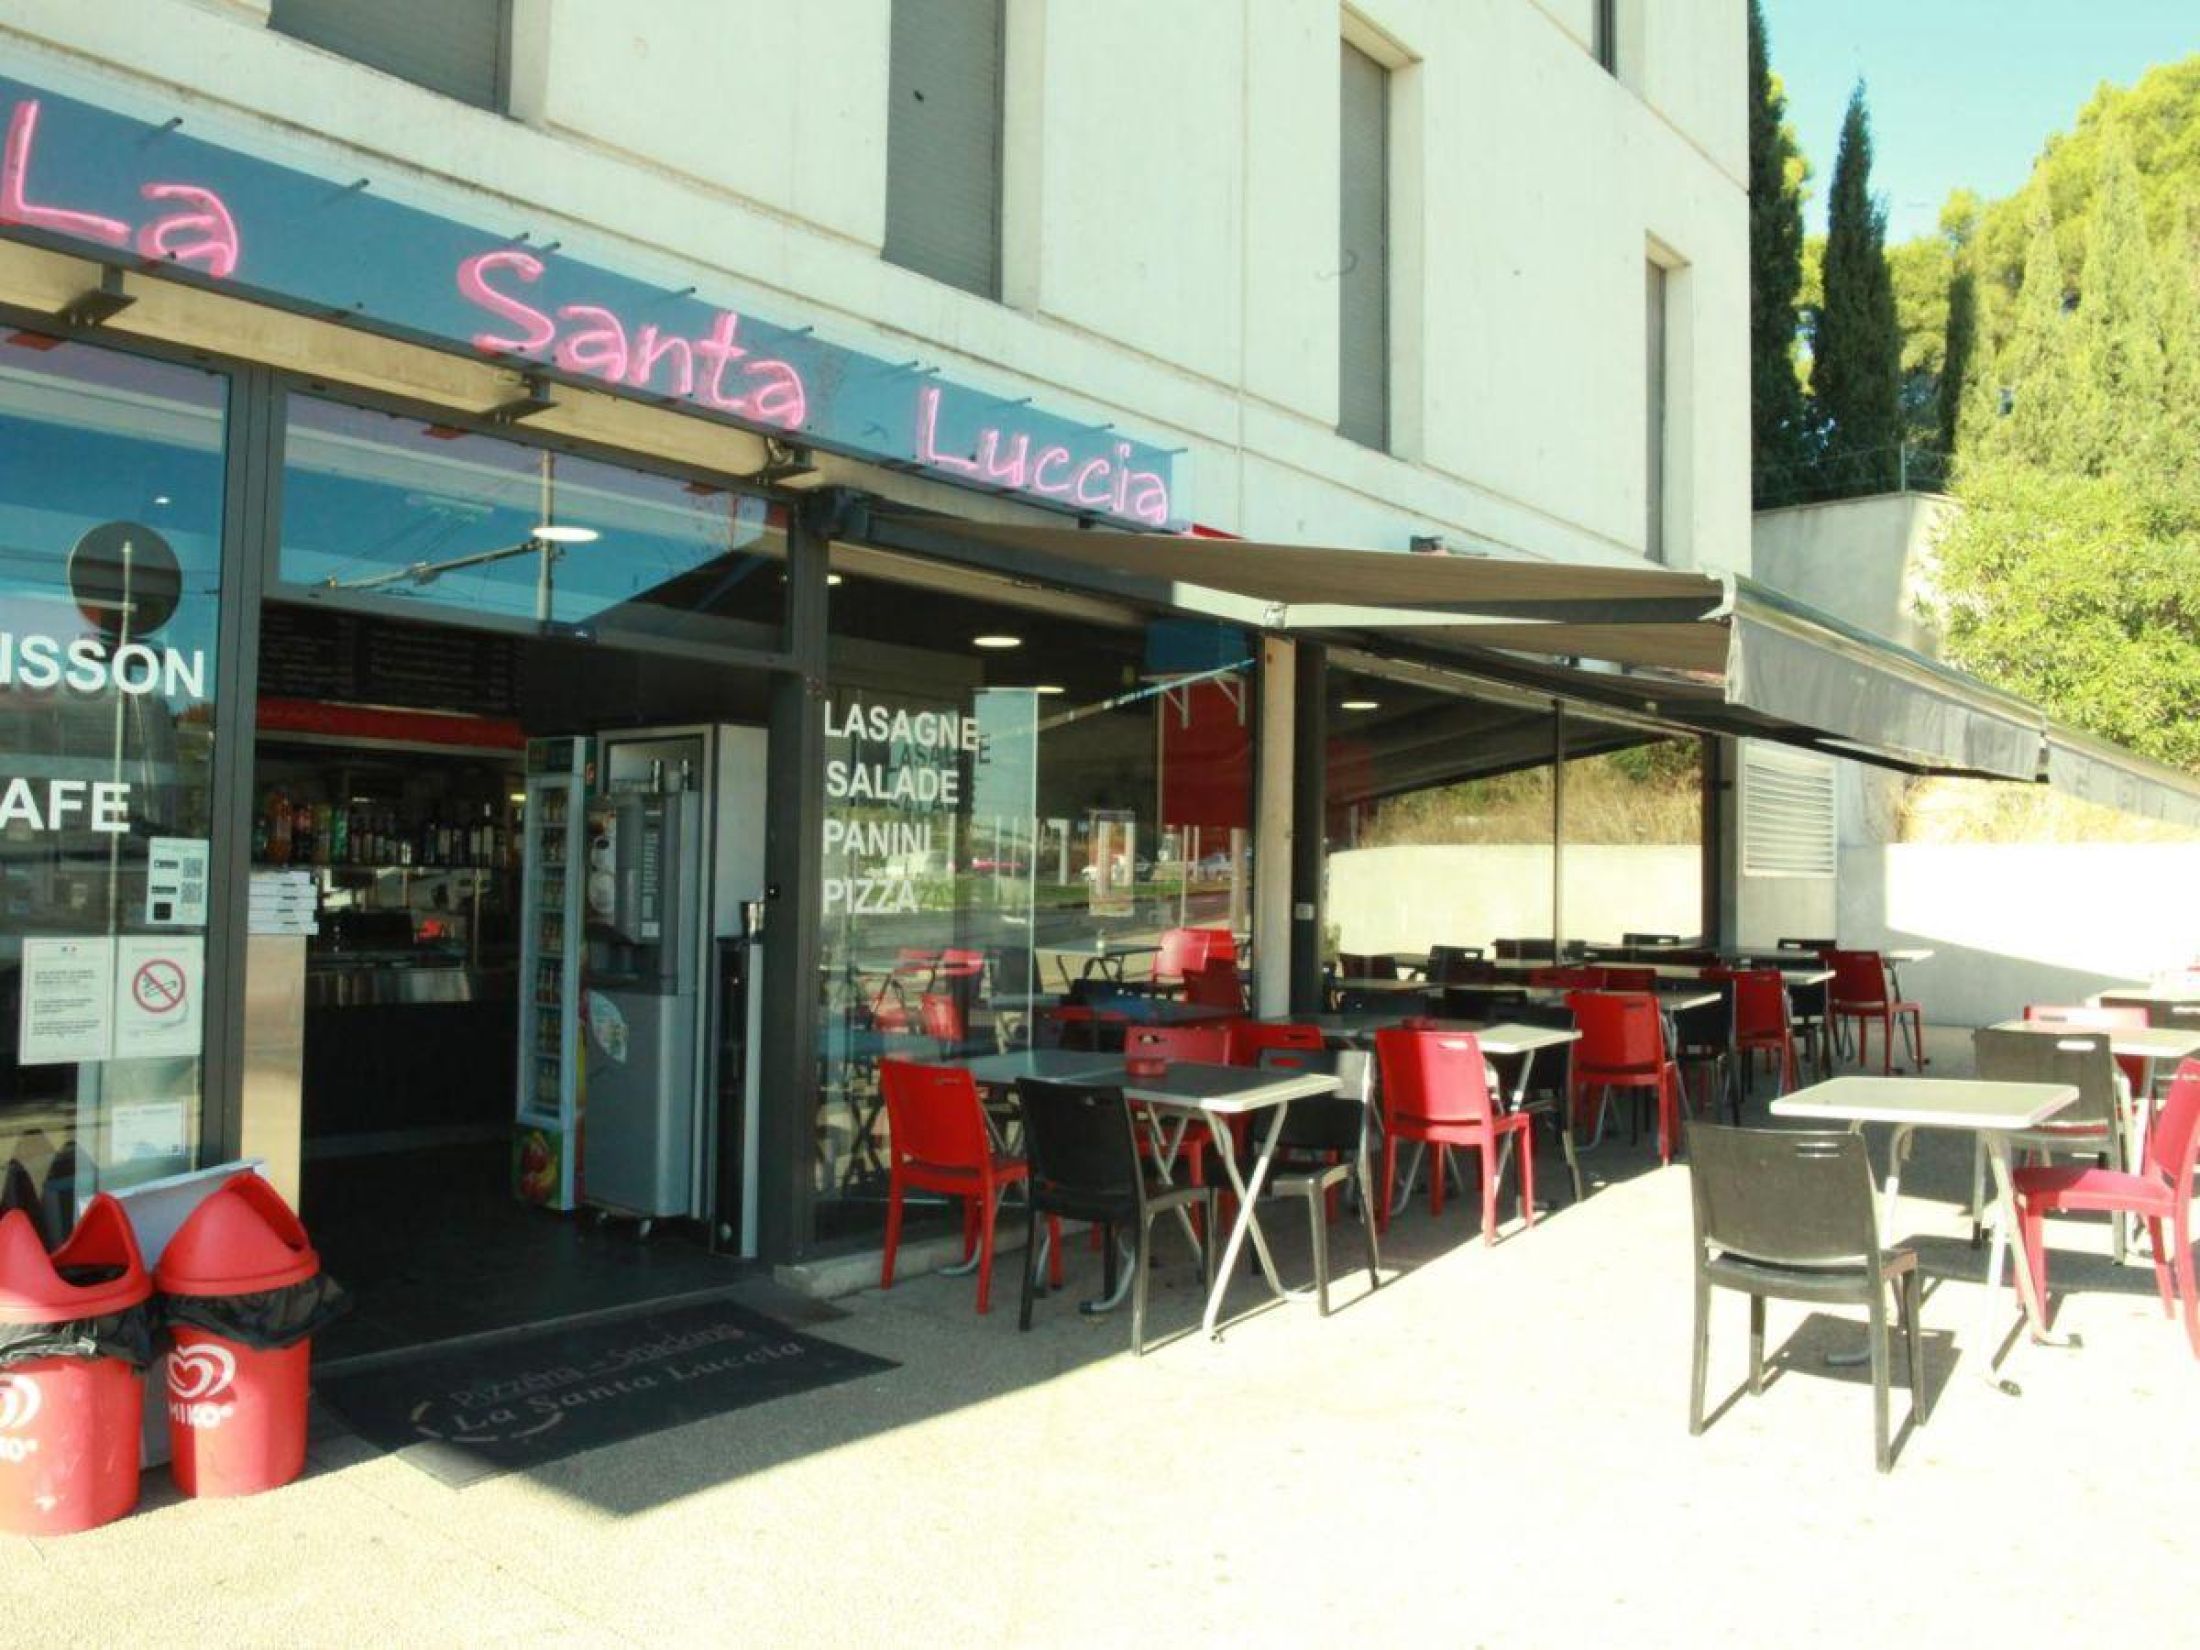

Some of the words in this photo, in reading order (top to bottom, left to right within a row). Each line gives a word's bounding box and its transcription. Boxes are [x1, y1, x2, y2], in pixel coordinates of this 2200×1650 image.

[2, 99, 238, 278] La
[457, 251, 807, 429] Santa
[917, 386, 1169, 526] Luccia
[824, 700, 980, 751] LASAGNE
[826, 760, 960, 804] SALADE
[823, 817, 931, 858] PANINI
[822, 876, 920, 915] PIZZA
[526, 1375, 659, 1414] Santa
